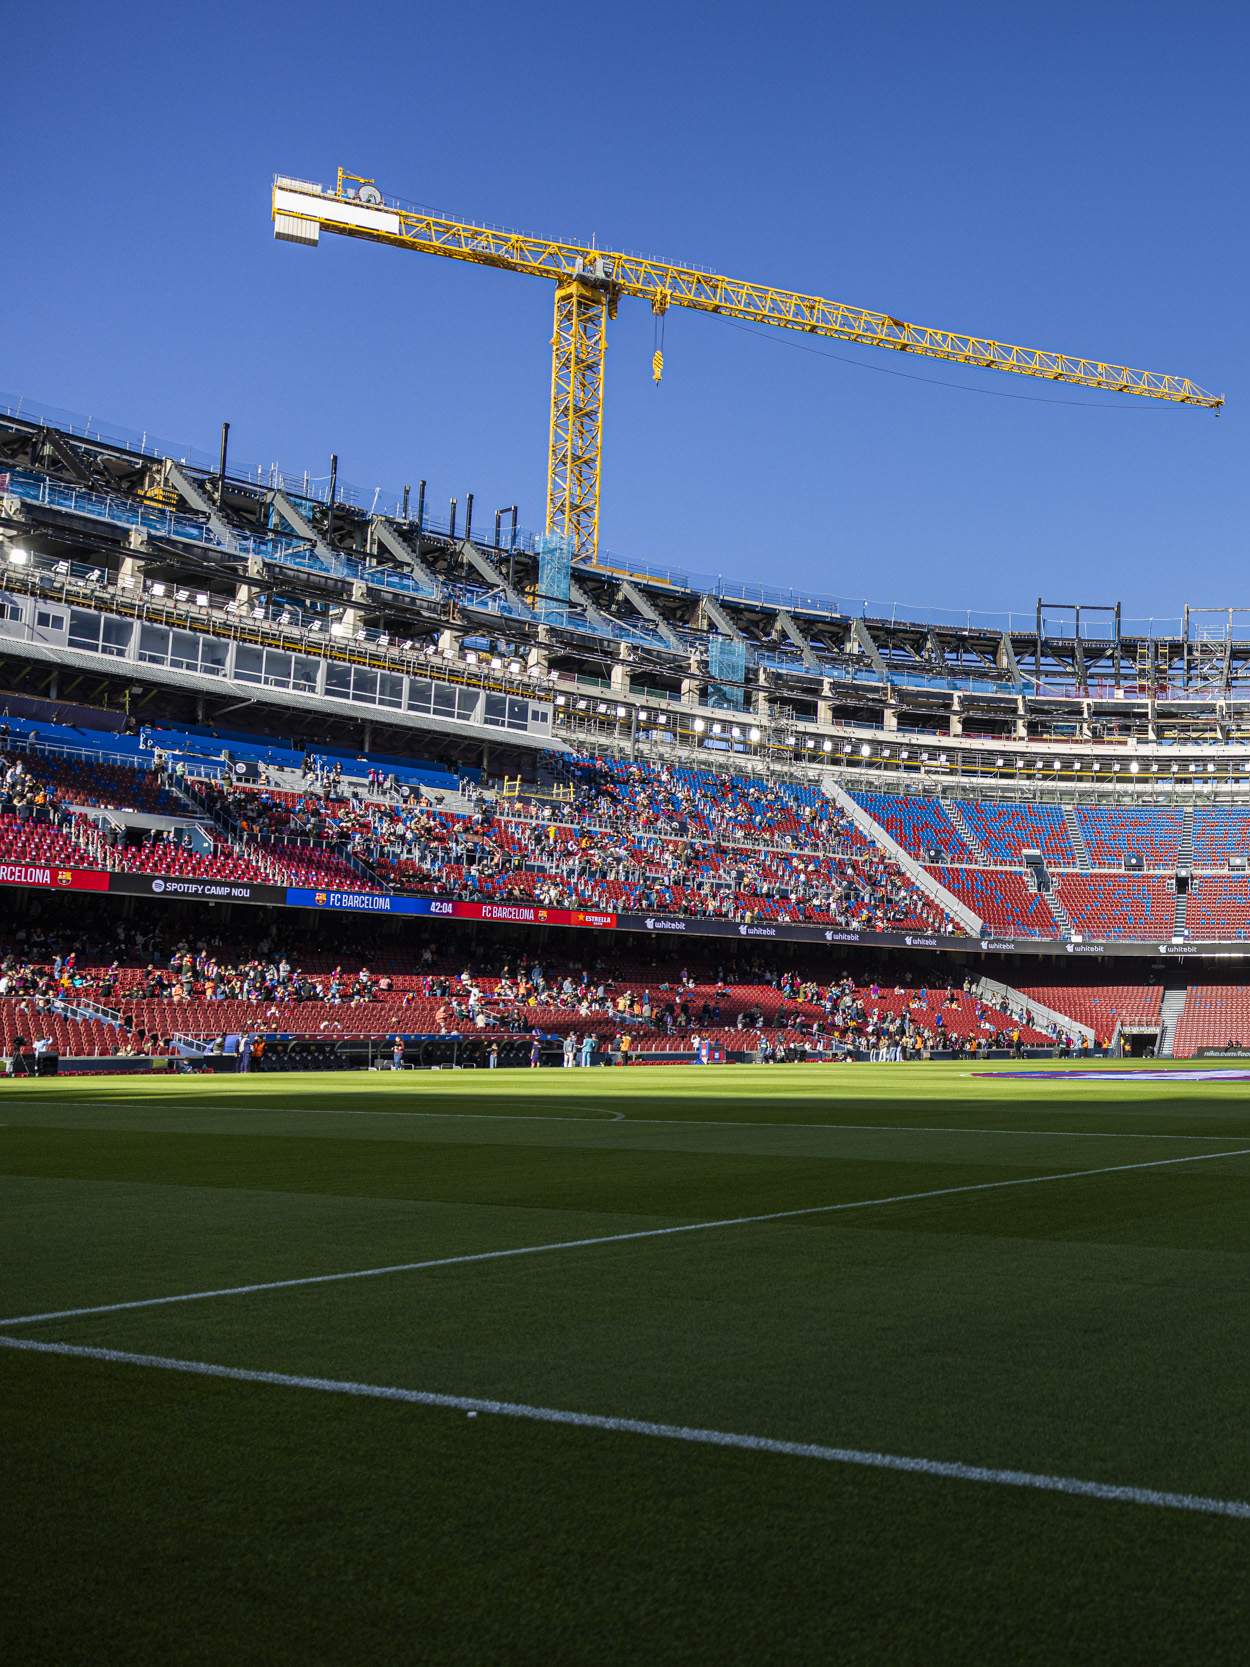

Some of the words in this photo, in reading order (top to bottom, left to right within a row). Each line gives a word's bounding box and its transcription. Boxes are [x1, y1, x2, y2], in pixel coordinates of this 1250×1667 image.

[166, 882, 203, 894] SPOTIFY
[204, 885, 231, 896] CAMP
[231, 887, 250, 897] NOU
[329, 893, 341, 906] FC
[342, 894, 391, 910] BARCELONA
[430, 901, 453, 914] 42:04
[481, 905, 492, 918] FC
[492, 906, 535, 921] BARCELONA
[654, 921, 686, 930] whitebit
[747, 927, 776, 936] whitebit
[832, 932, 860, 941] whitebit
[912, 937, 937, 946] whitebit
[988, 942, 1015, 950] whitebit
[1074, 944, 1104, 953] whitebit
[1167, 945, 1197, 953] whitebit
